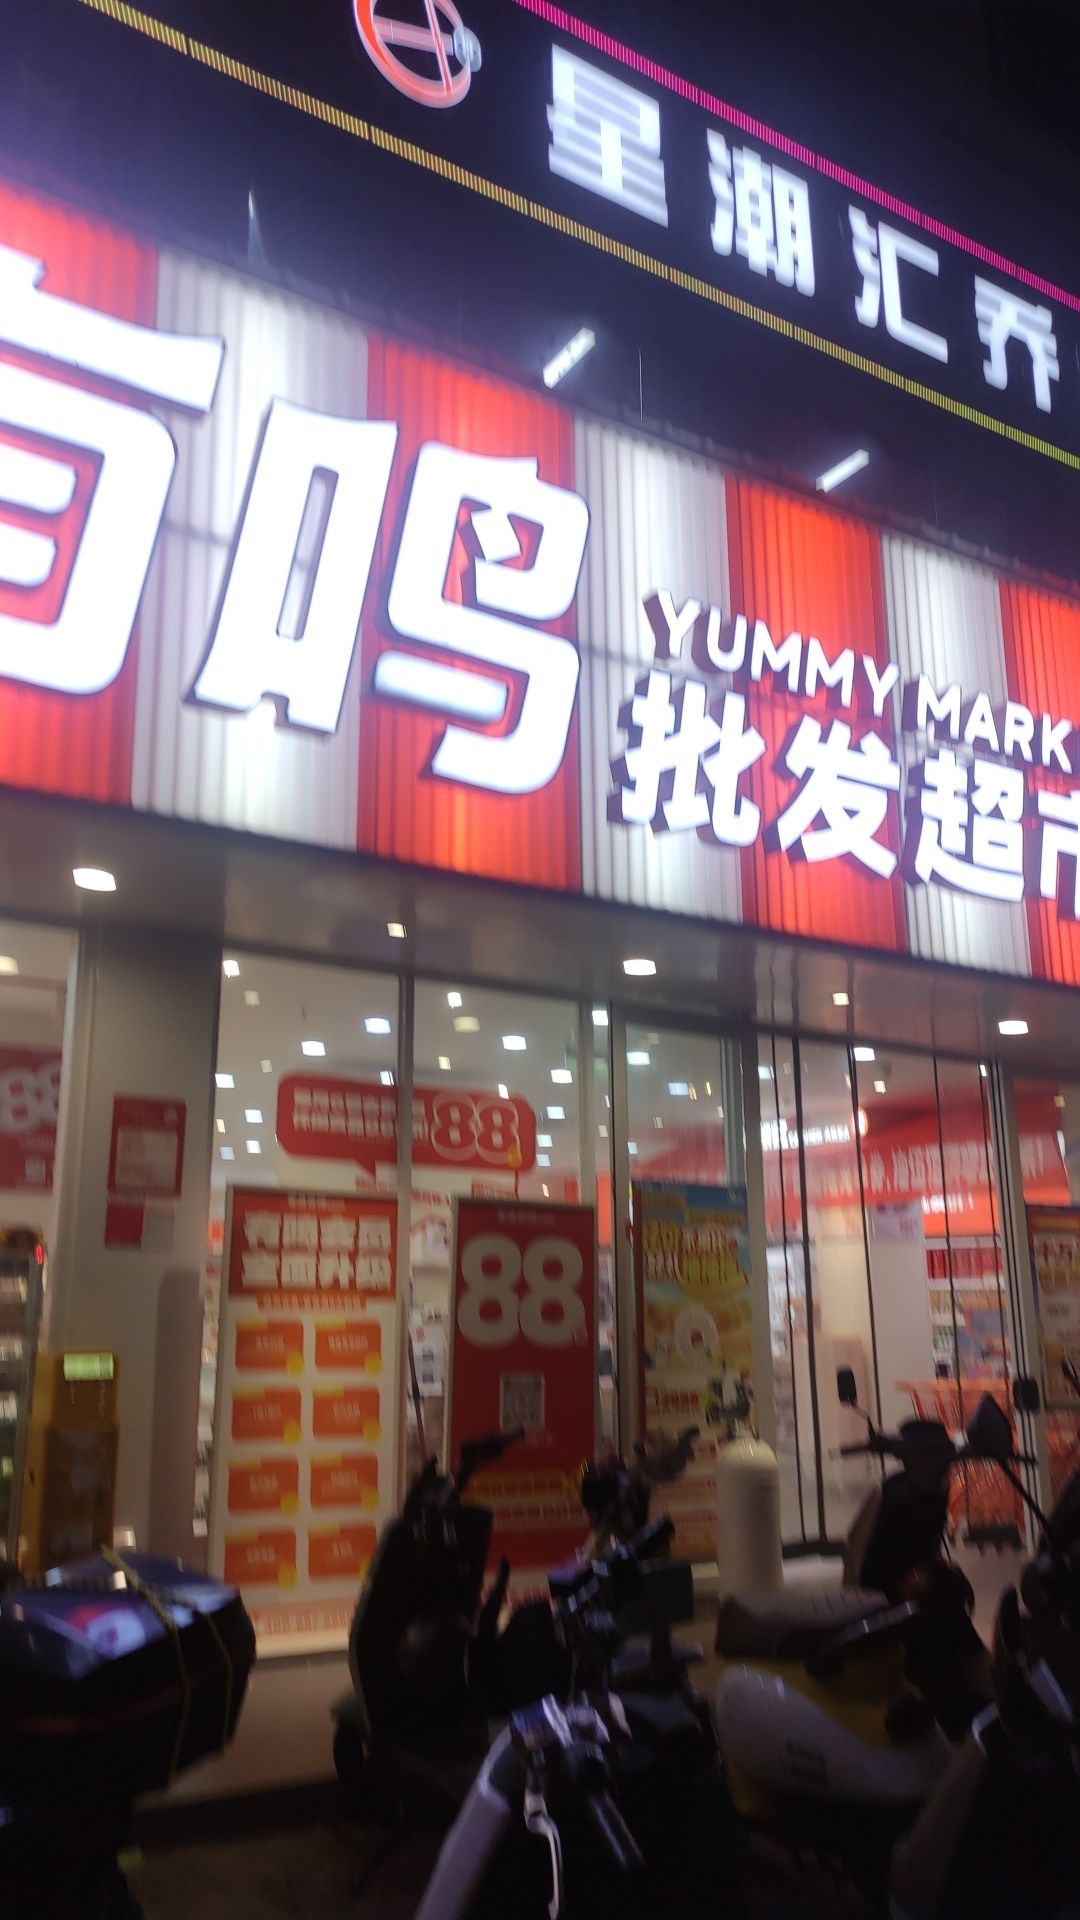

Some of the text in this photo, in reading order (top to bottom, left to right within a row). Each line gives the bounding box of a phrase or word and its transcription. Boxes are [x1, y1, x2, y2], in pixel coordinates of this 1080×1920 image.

[648, 588, 899, 718] YUMMY
[432, 1091, 522, 1163] 88
[457, 1233, 586, 1347] 88
